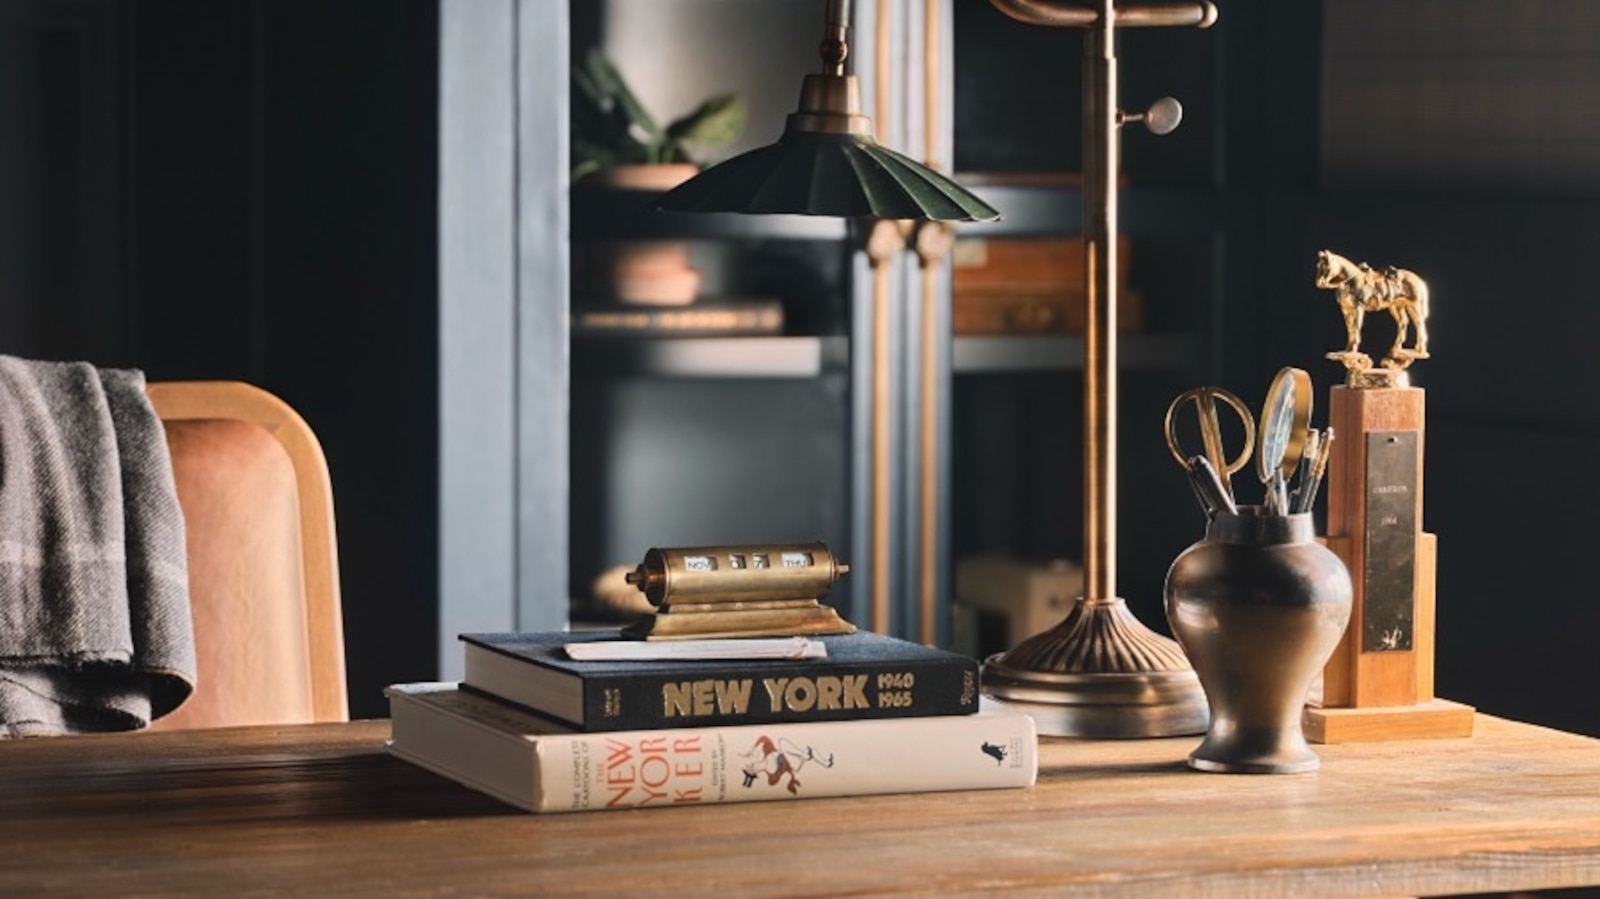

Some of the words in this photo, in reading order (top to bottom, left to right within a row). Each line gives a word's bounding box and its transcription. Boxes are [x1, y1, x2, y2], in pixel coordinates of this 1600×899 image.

[688, 561, 711, 570] NOV
[785, 559, 806, 568] THU
[877, 672, 914, 689] 1940
[662, 679, 753, 718] NEW
[763, 675, 870, 713] YORK
[878, 691, 913, 709] 1965
[581, 741, 590, 753] OF
[581, 756, 590, 808] CARTOONS
[604, 738, 636, 808] NEW
[639, 736, 670, 806] YOR
[673, 736, 703, 803] KER
[572, 792, 580, 808] THE
